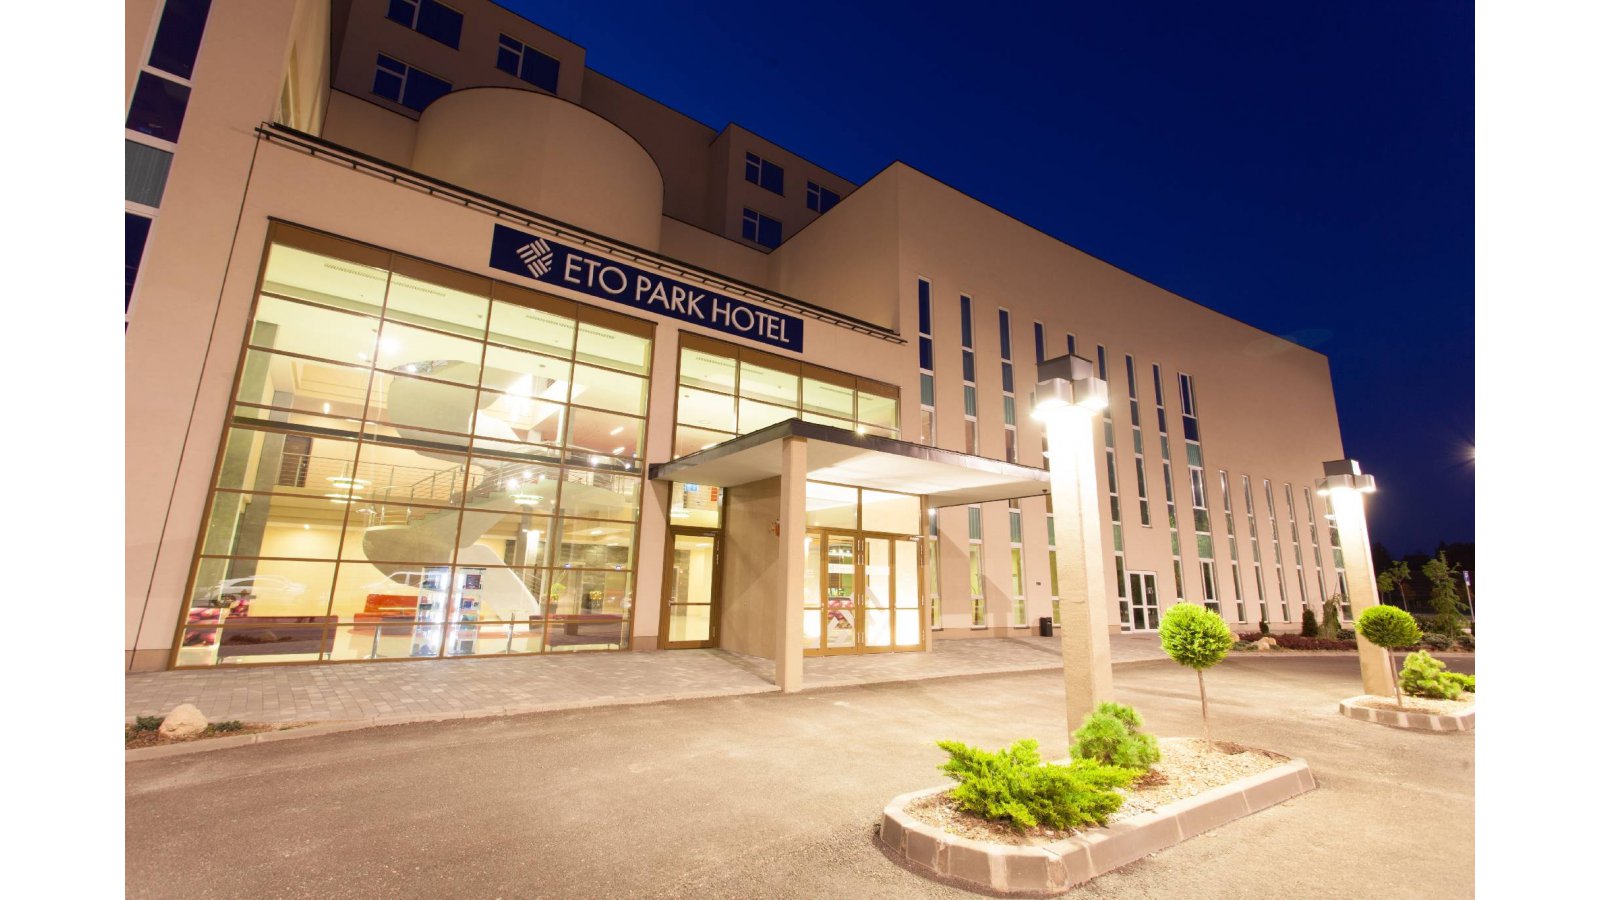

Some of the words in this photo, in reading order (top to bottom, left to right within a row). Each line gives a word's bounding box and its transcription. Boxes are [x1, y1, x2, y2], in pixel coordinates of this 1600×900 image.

[564, 252, 628, 295] ETO
[635, 275, 705, 320] PARK
[711, 298, 791, 343] HOTEL
